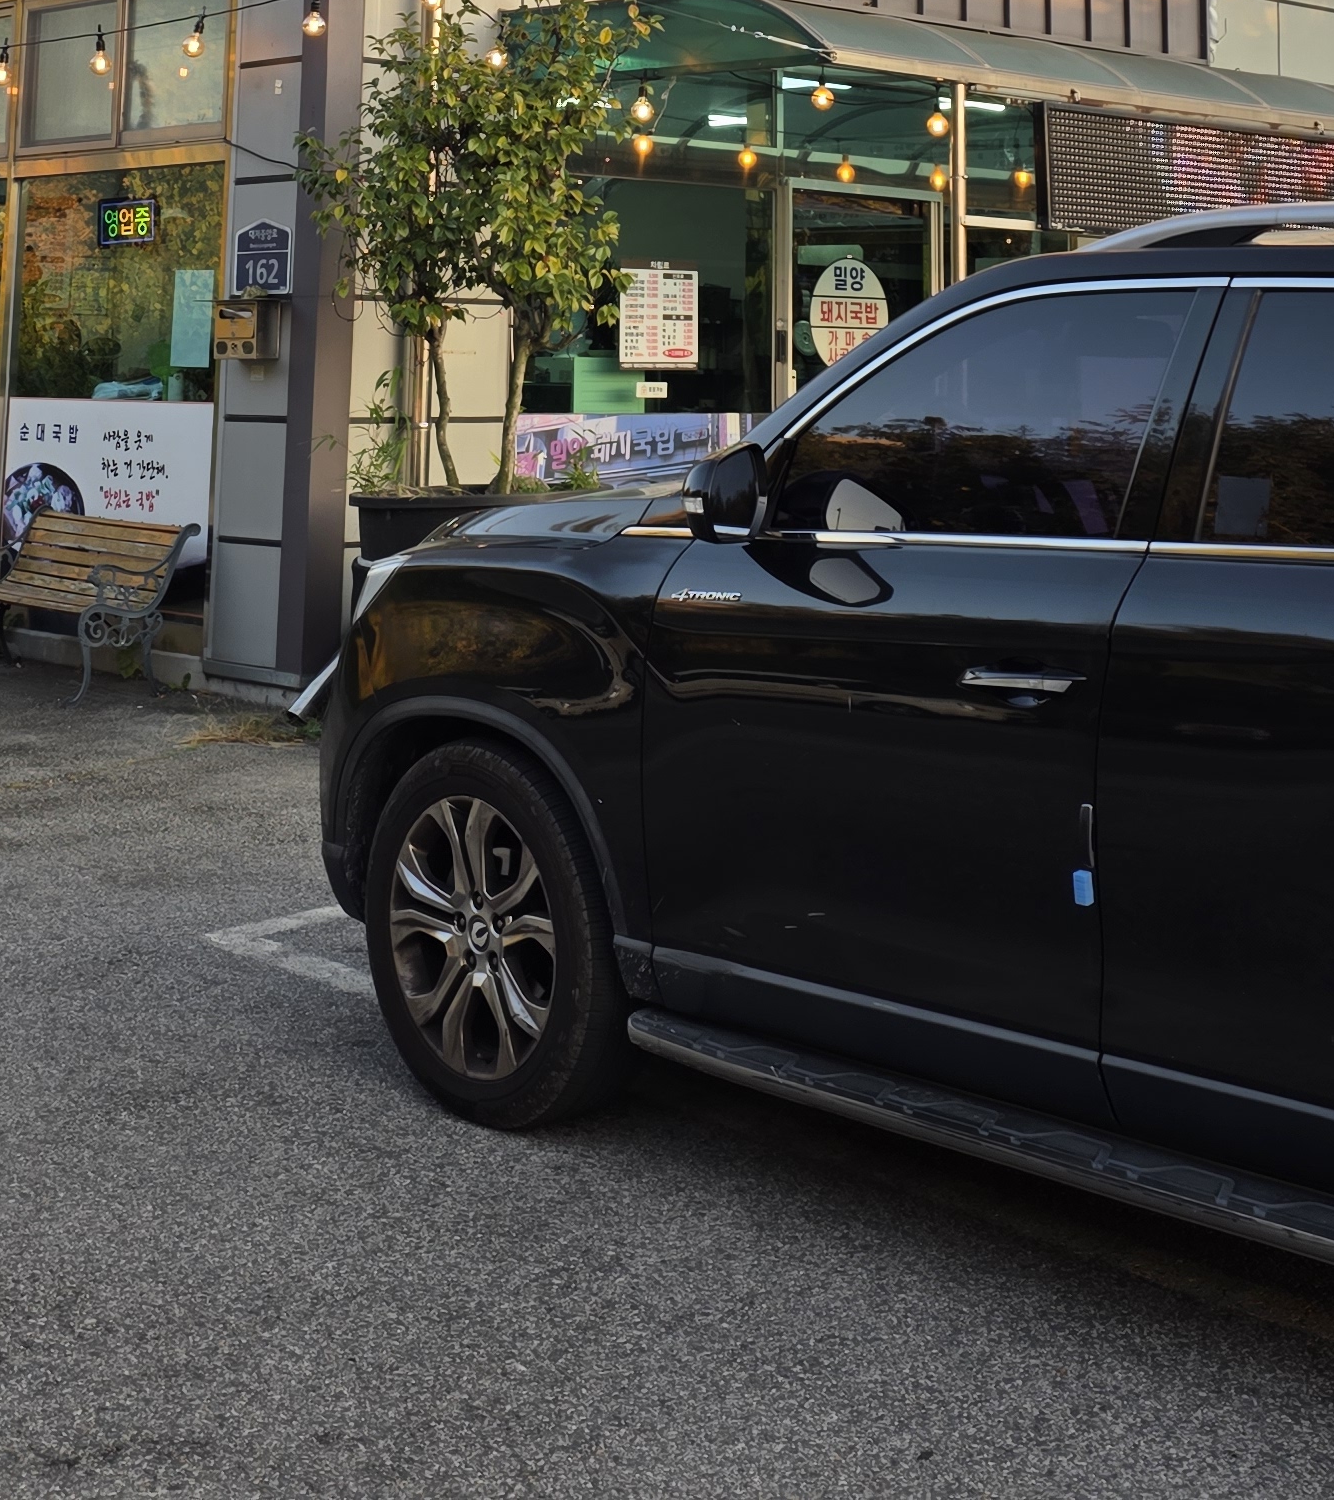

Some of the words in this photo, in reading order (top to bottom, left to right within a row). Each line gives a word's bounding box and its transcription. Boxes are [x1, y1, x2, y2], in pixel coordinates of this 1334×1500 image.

[104, 206, 151, 237] 영업중
[245, 258, 279, 285] 162
[833, 266, 866, 292] 밀양
[819, 300, 879, 325] 돼지국밥
[19, 422, 79, 444] 순대국밥
[102, 428, 131, 452] 사람을
[133, 429, 154, 451] 웃게
[590, 425, 679, 464] 돼지국밥
[101, 456, 119, 479] 하는
[123, 458, 133, 479] 건
[136, 458, 169, 480] 간단해.
[670, 587, 743, 602] 4TRONIC
